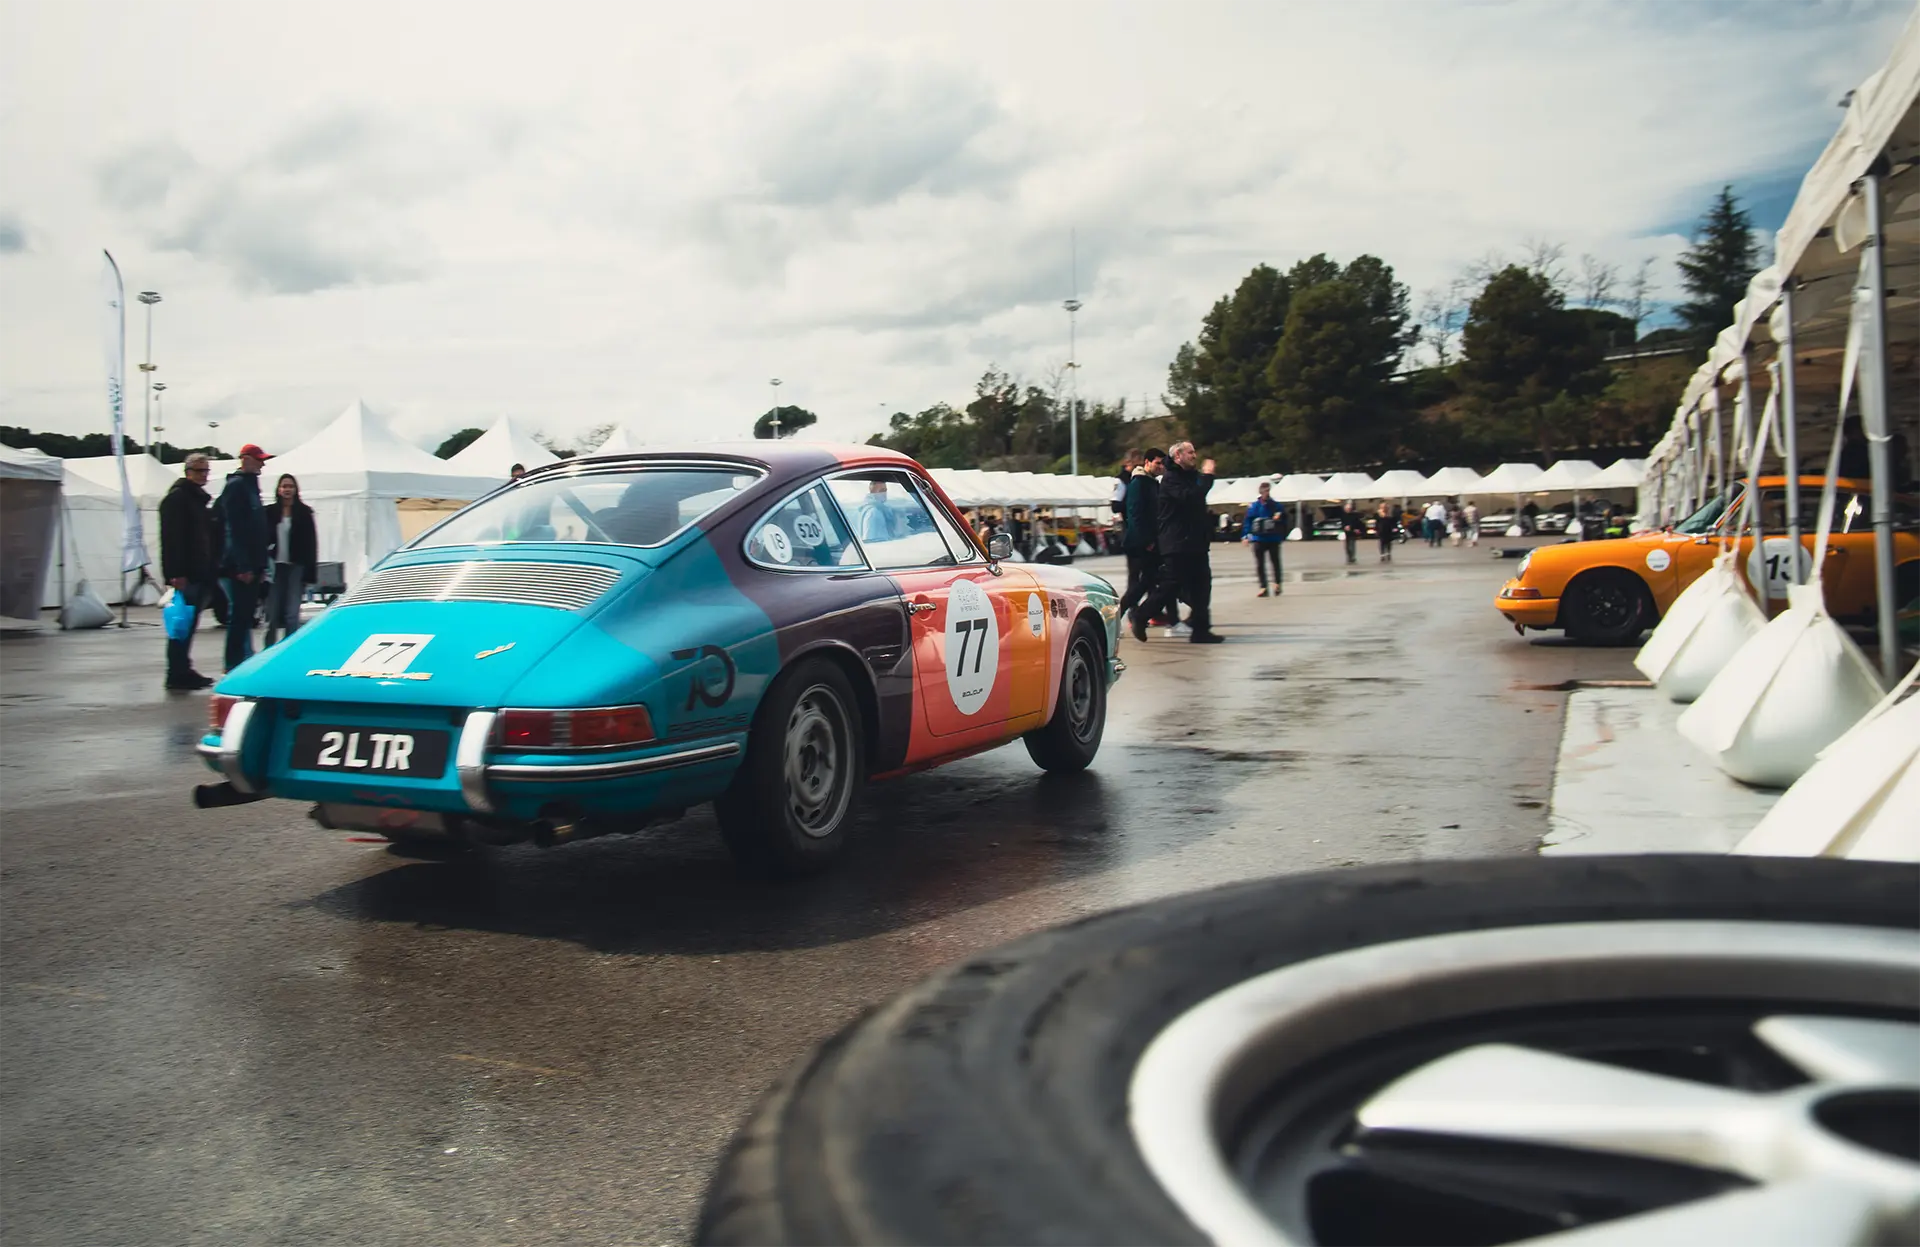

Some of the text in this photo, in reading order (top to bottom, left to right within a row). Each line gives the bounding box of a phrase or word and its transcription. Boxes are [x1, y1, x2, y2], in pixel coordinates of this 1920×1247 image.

[797, 522, 820, 538] 520
[770, 533, 785, 550] 18
[361, 641, 417, 664] 77
[956, 618, 989, 677] 77
[669, 712, 749, 732] PORSCHE
[317, 731, 415, 770] 2LTR
